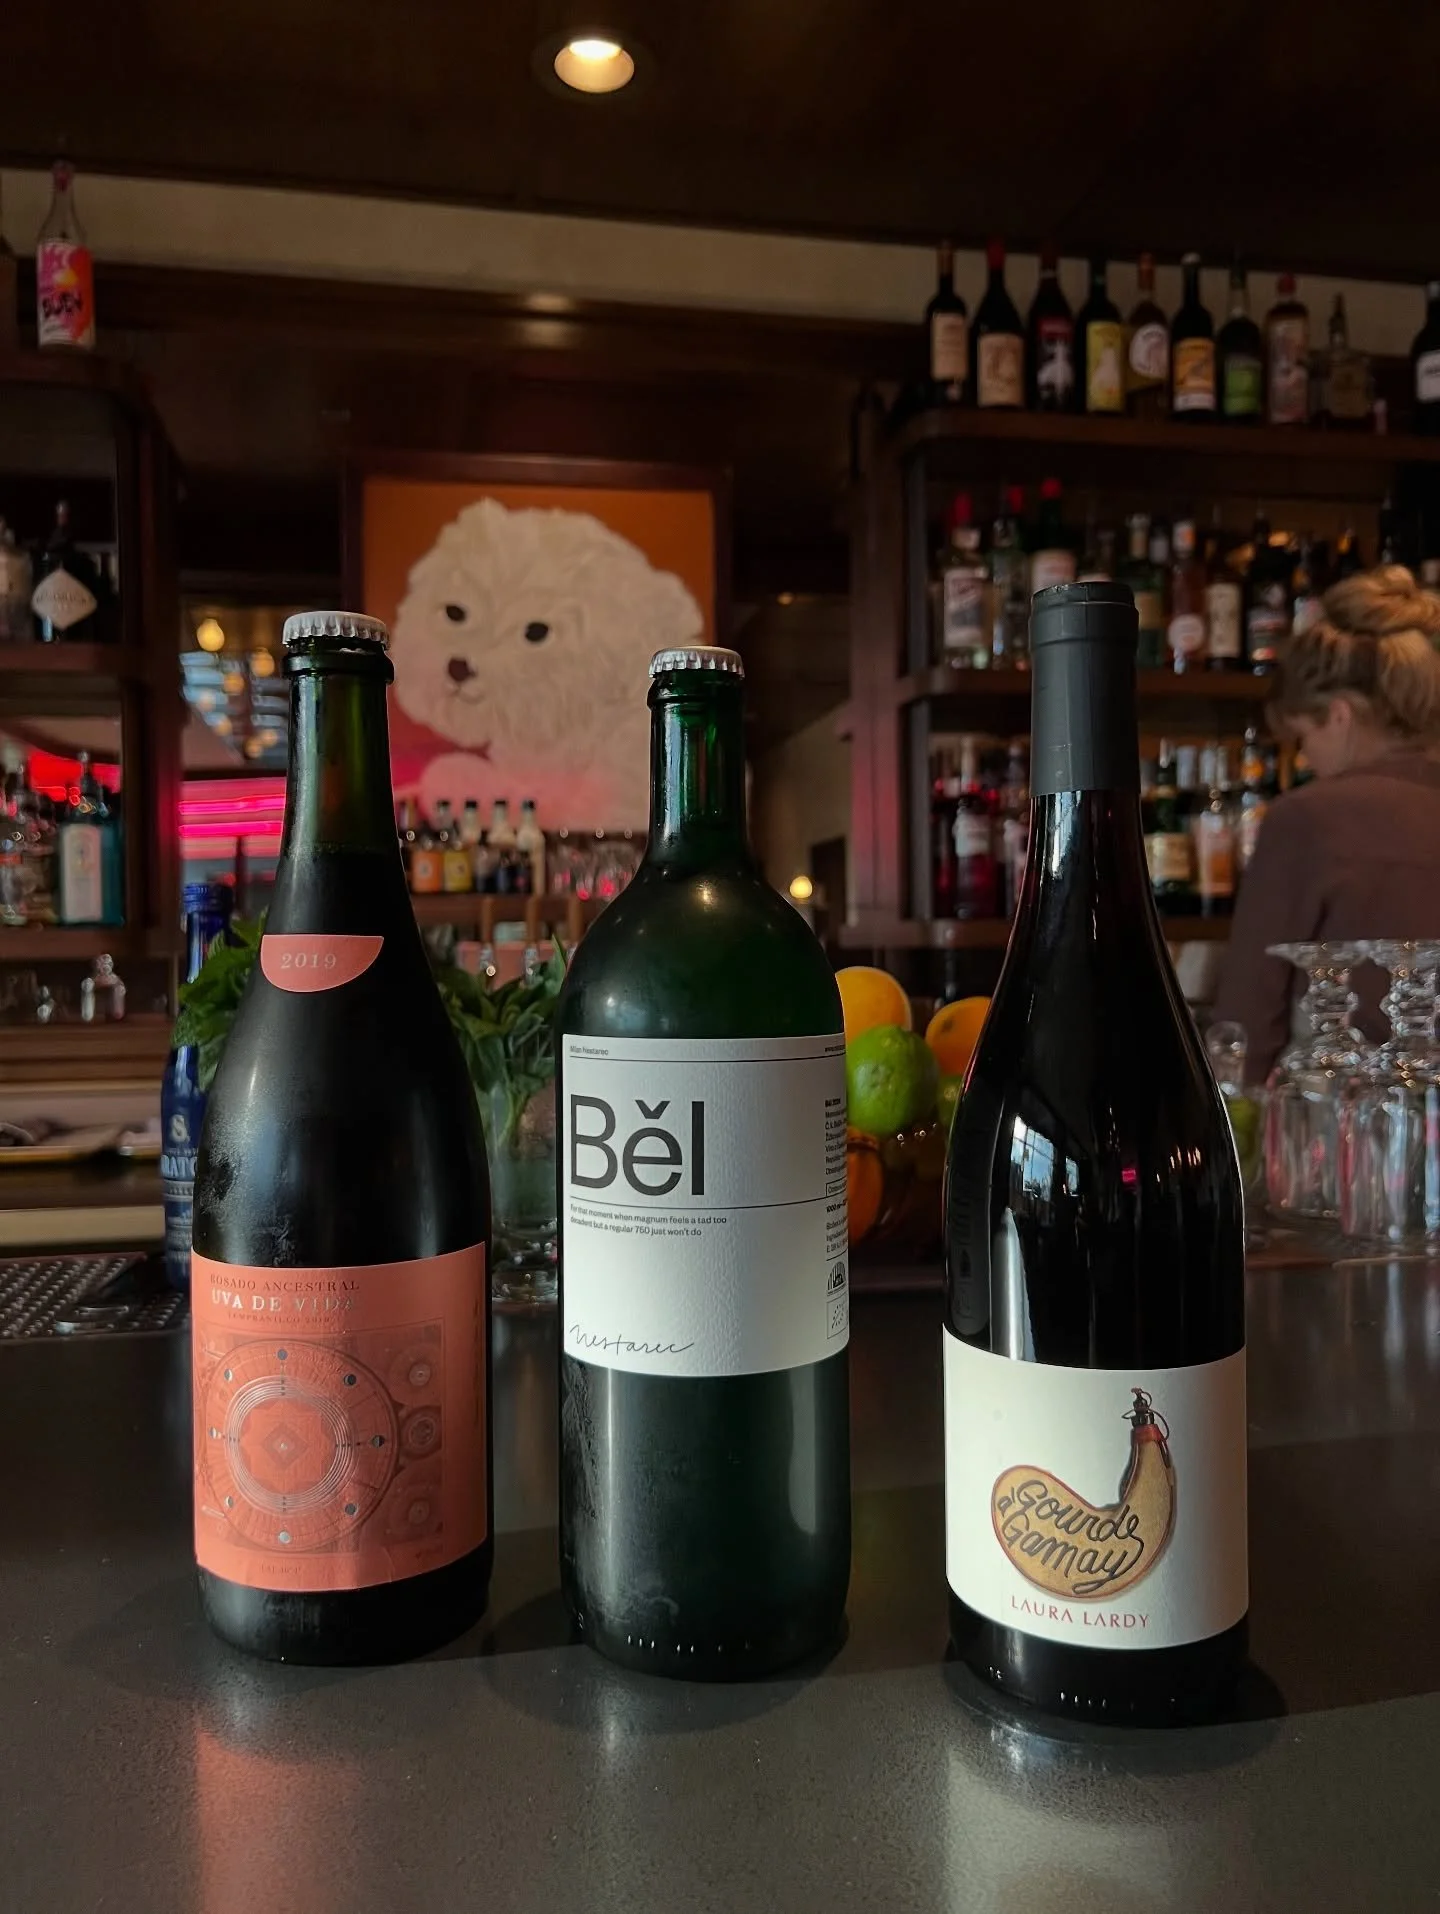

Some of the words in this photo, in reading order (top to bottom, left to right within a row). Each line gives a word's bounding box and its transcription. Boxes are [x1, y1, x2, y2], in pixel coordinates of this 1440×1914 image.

[280, 952, 337, 970] 2019
[570, 1094, 705, 1196] Běl
[588, 1209, 613, 1219] moment
[614, 1212, 633, 1221] when
[634, 1214, 668, 1225] magnum
[669, 1215, 689, 1224] feels
[697, 1215, 711, 1224] tad
[713, 1216, 727, 1224] too
[593, 1220, 603, 1229] but
[609, 1223, 633, 1233] regular
[650, 1226, 666, 1236] just
[667, 1226, 690, 1236] won't
[690, 1227, 702, 1236] do
[263, 1280, 360, 1292] ANCESTRAL
[211, 1287, 243, 1309] UVA
[252, 1295, 281, 1312] DE
[294, 1295, 356, 1312] VIDA
[1016, 1479, 1140, 1542] Gourde
[1001, 1512, 1131, 1594] Gamay
[1011, 1595, 1073, 1624] LAURA
[1083, 1611, 1150, 1628] LARDY
